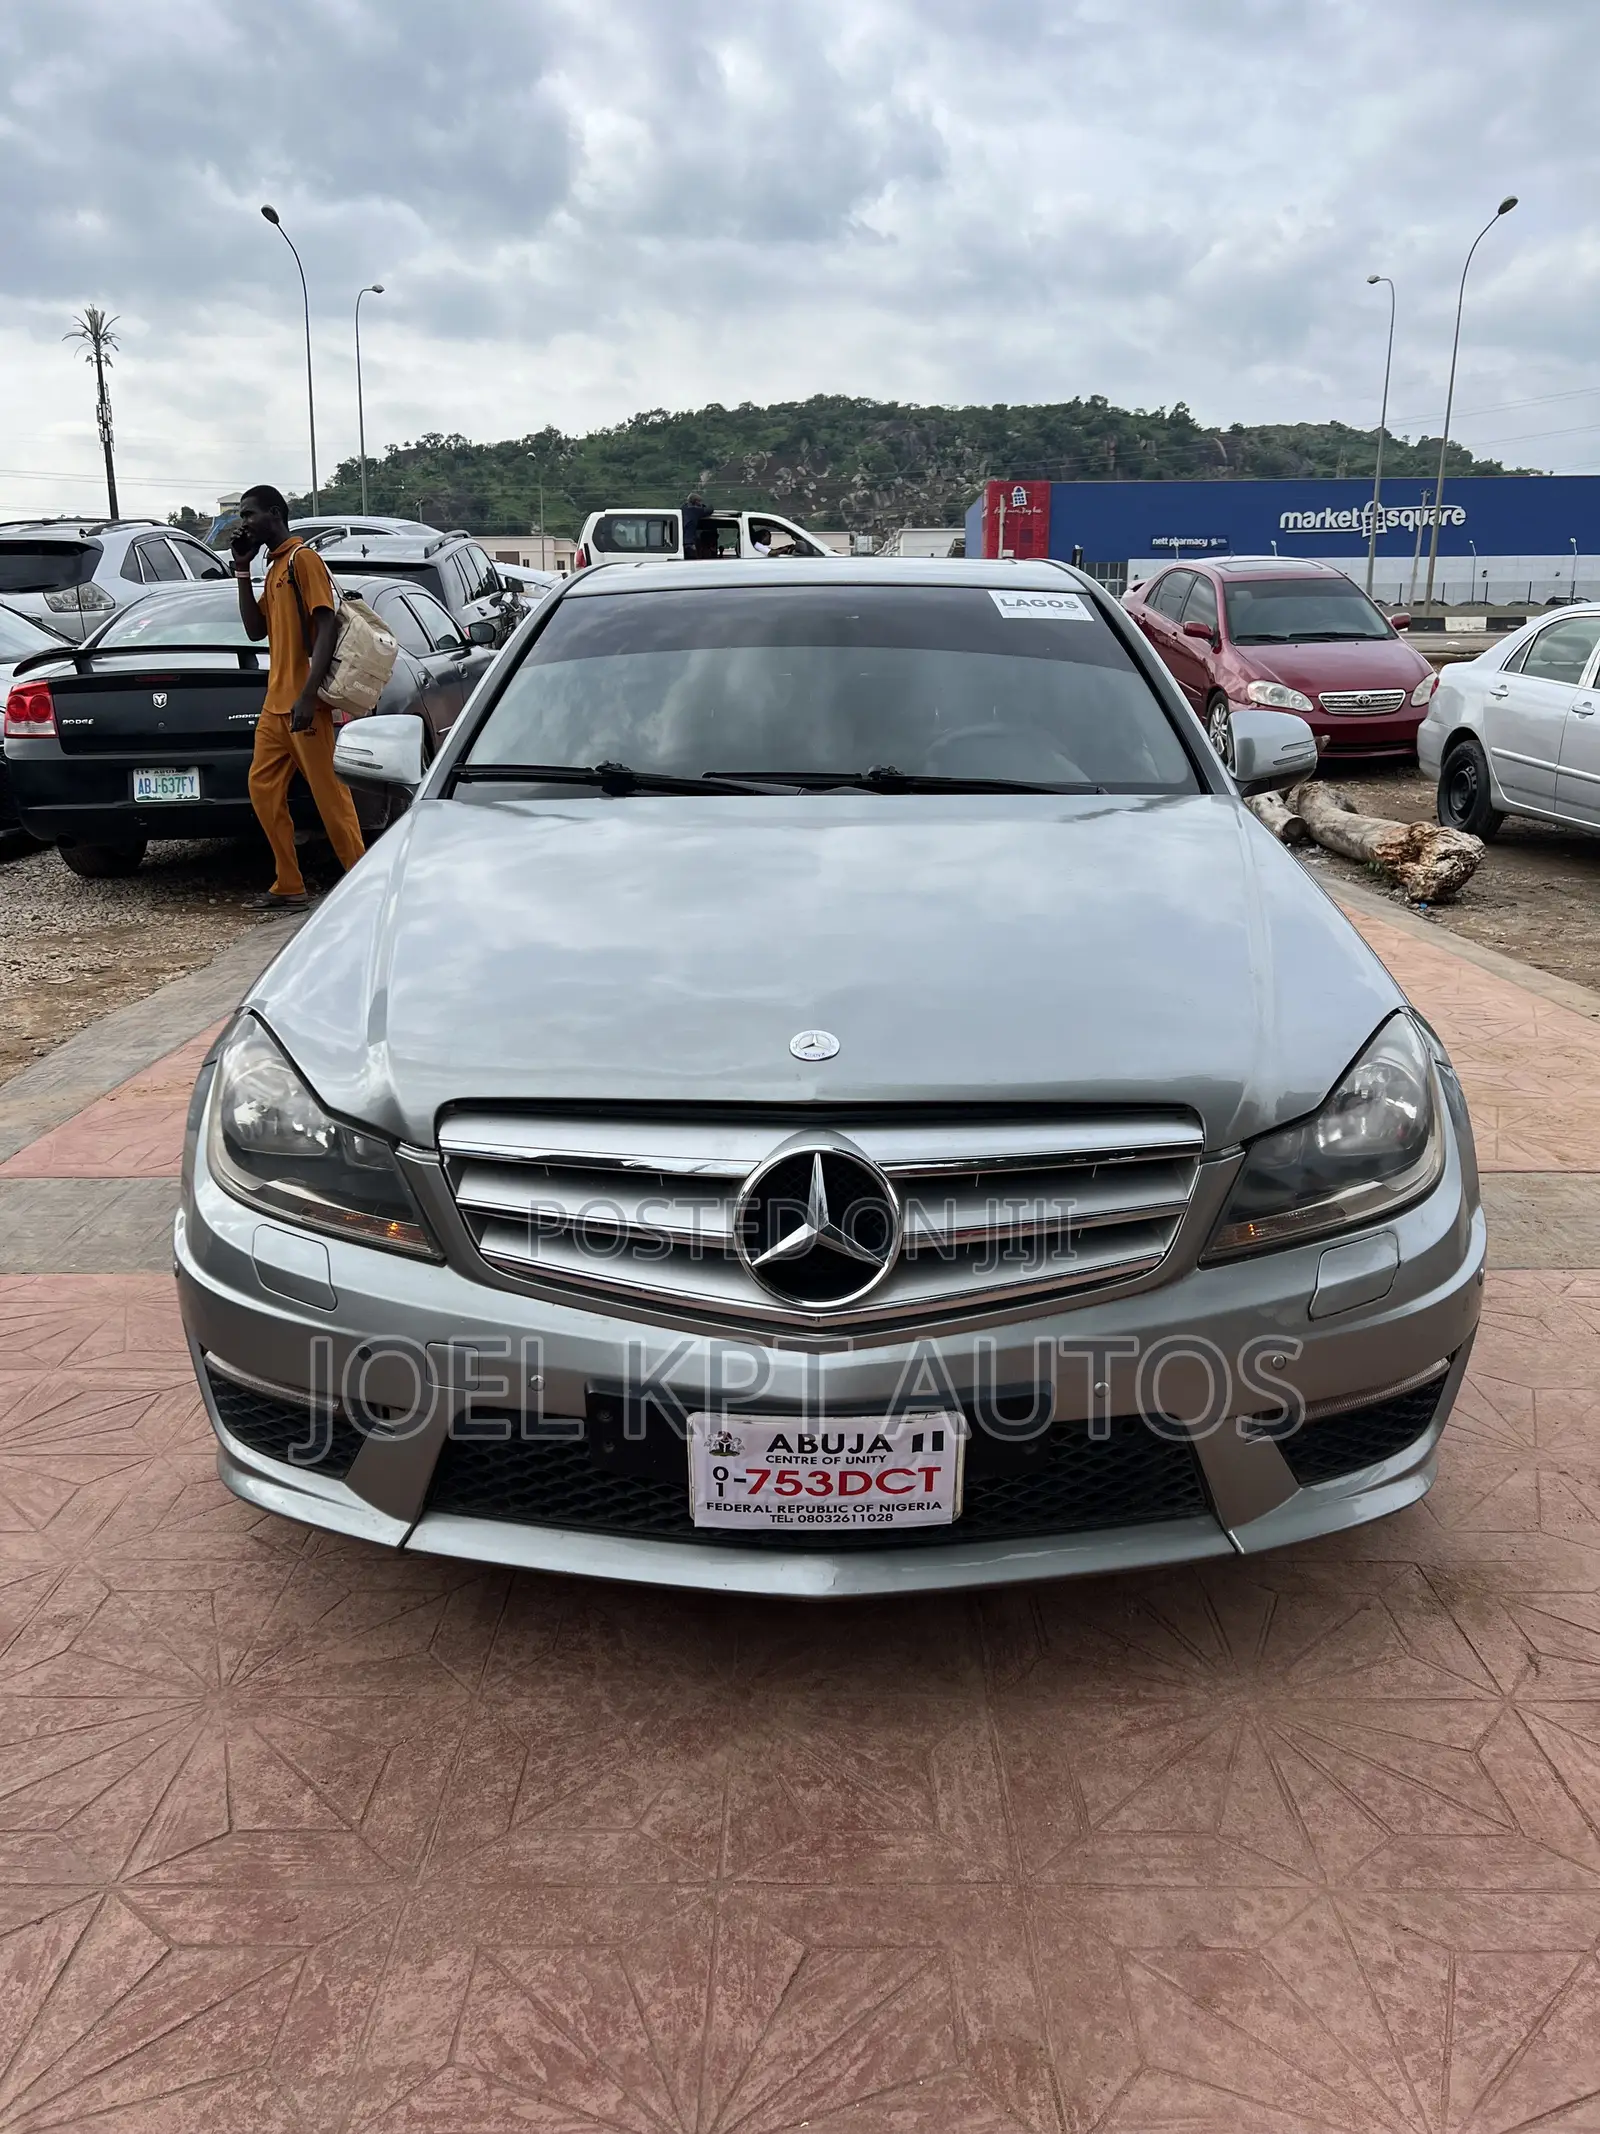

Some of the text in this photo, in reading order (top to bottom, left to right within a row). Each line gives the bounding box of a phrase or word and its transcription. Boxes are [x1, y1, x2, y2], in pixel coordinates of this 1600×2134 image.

[1279, 507, 1466, 532] market square
[1169, 537, 1208, 547] pharmacy
[1000, 599, 1079, 609] LAGOS
[766, 1433, 894, 1455] ABUJA
[765, 1455, 887, 1465] CENTRE OF UNITY
[706, 1501, 942, 1514] FEDERAL REPUBLIC OF NIGERIA
[798, 1513, 894, 1524] 08032611028
